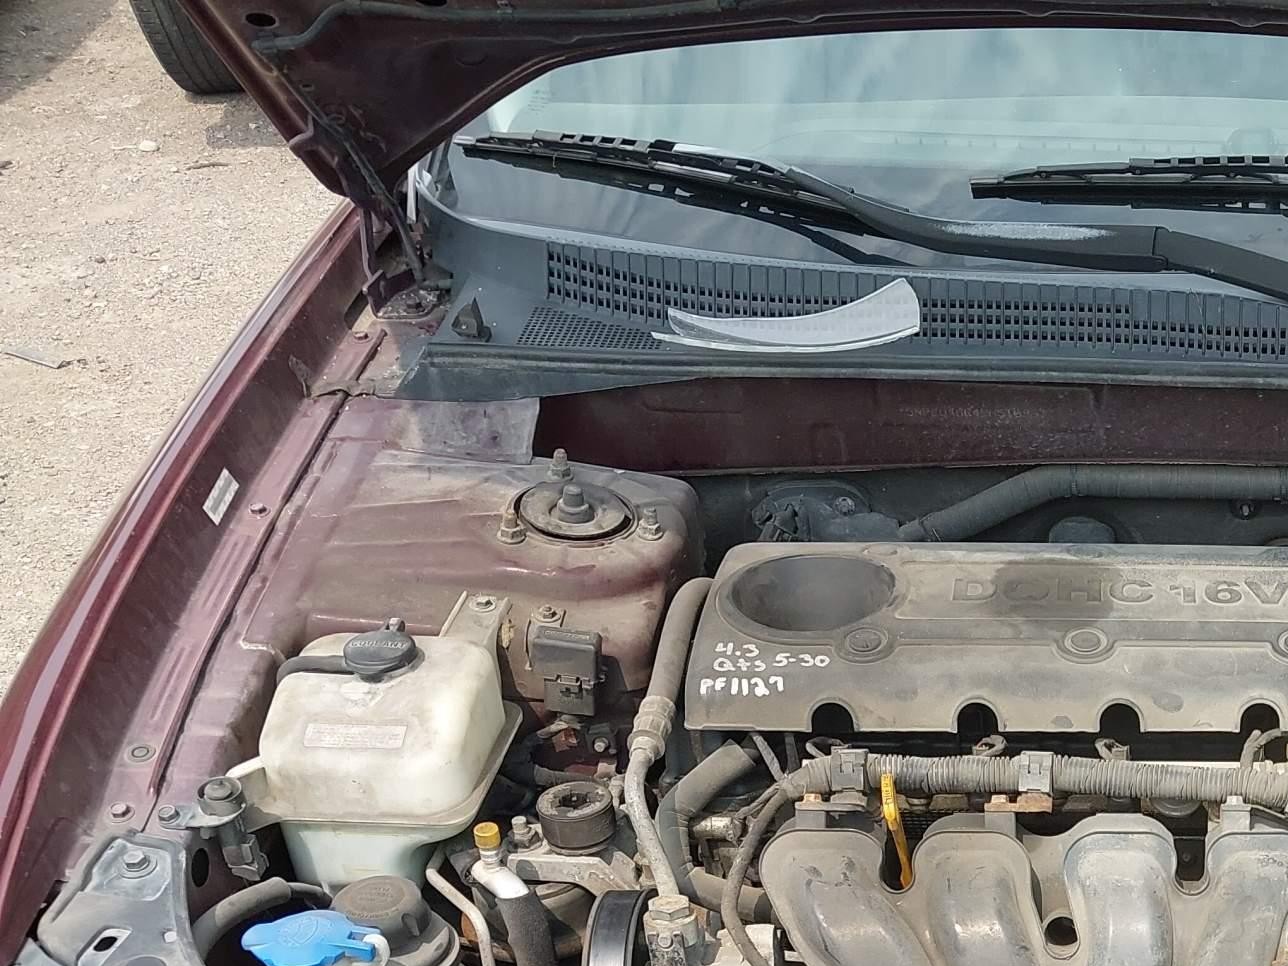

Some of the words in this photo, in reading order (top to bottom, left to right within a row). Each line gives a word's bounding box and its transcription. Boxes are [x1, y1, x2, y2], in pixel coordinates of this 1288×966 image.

[952, 577, 1154, 605] DOHC
[714, 641, 760, 658] 4.3
[772, 652, 831, 668] 5-30
